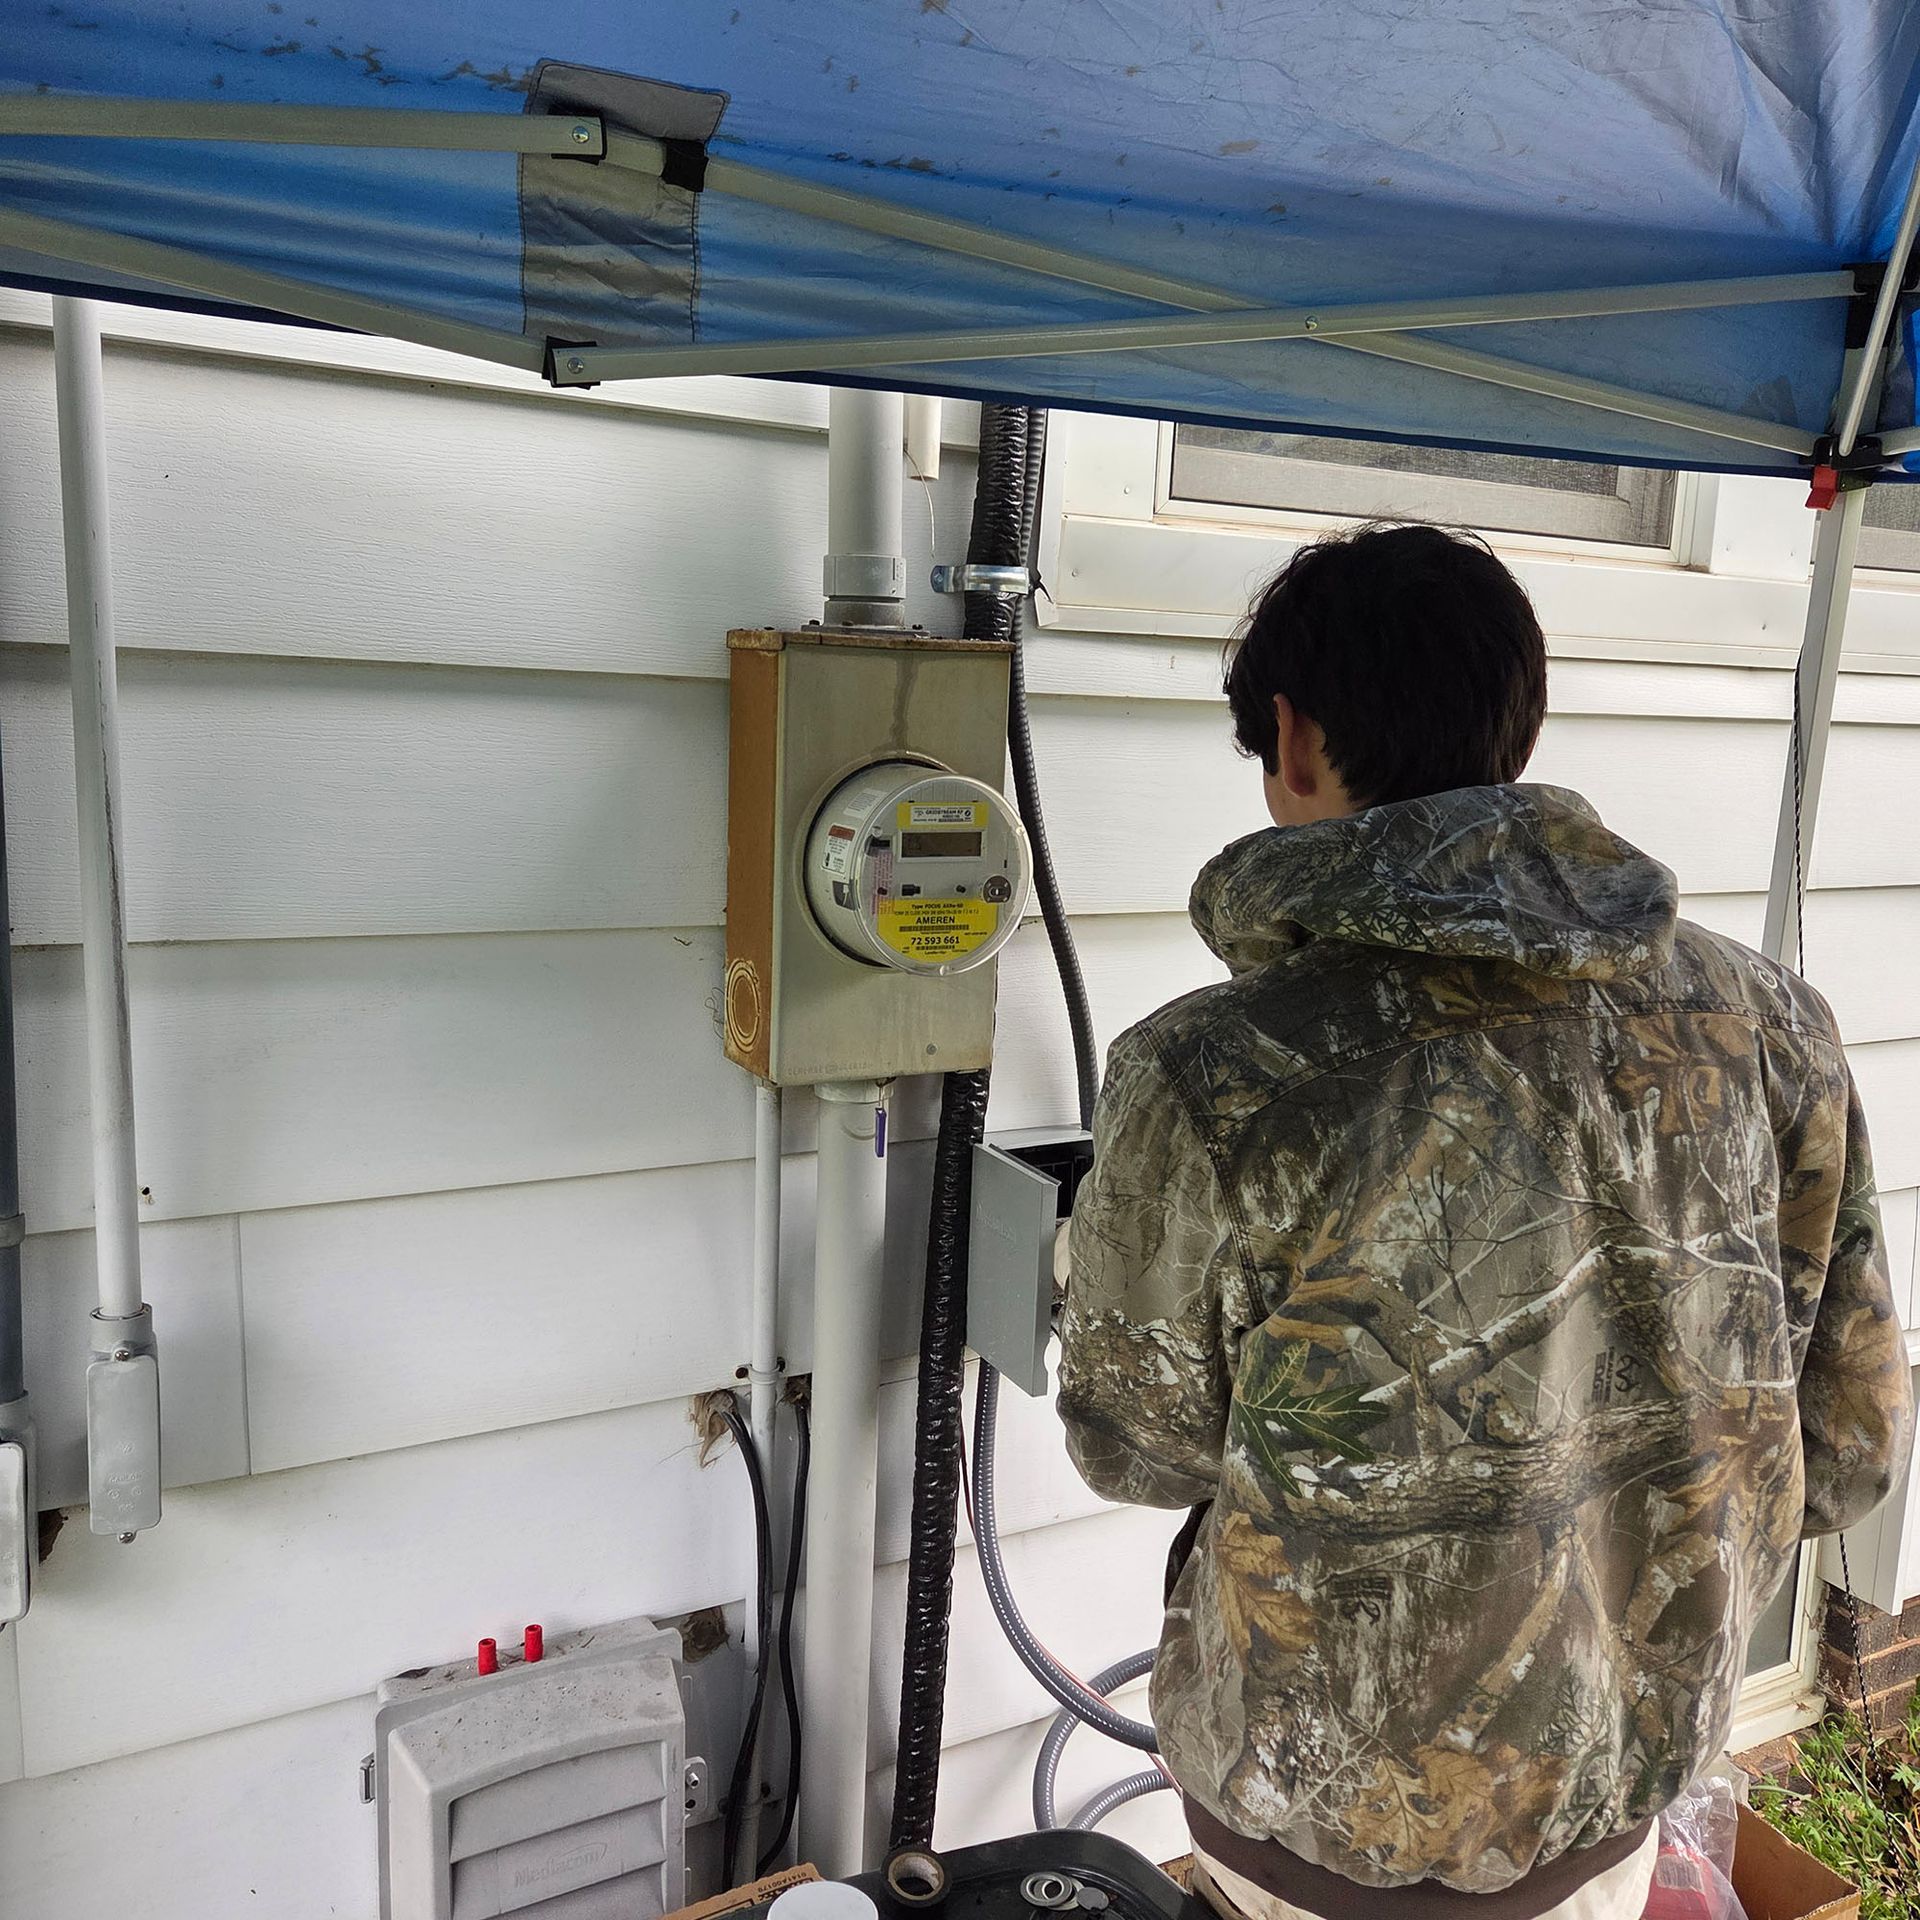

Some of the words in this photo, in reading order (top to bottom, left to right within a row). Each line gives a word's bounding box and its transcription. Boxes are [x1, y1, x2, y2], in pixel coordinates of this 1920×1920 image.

[915, 916, 956, 925] AMEREN
[911, 936, 922, 945] 72
[924, 936, 942, 945] 593
[943, 935, 960, 944] 661
